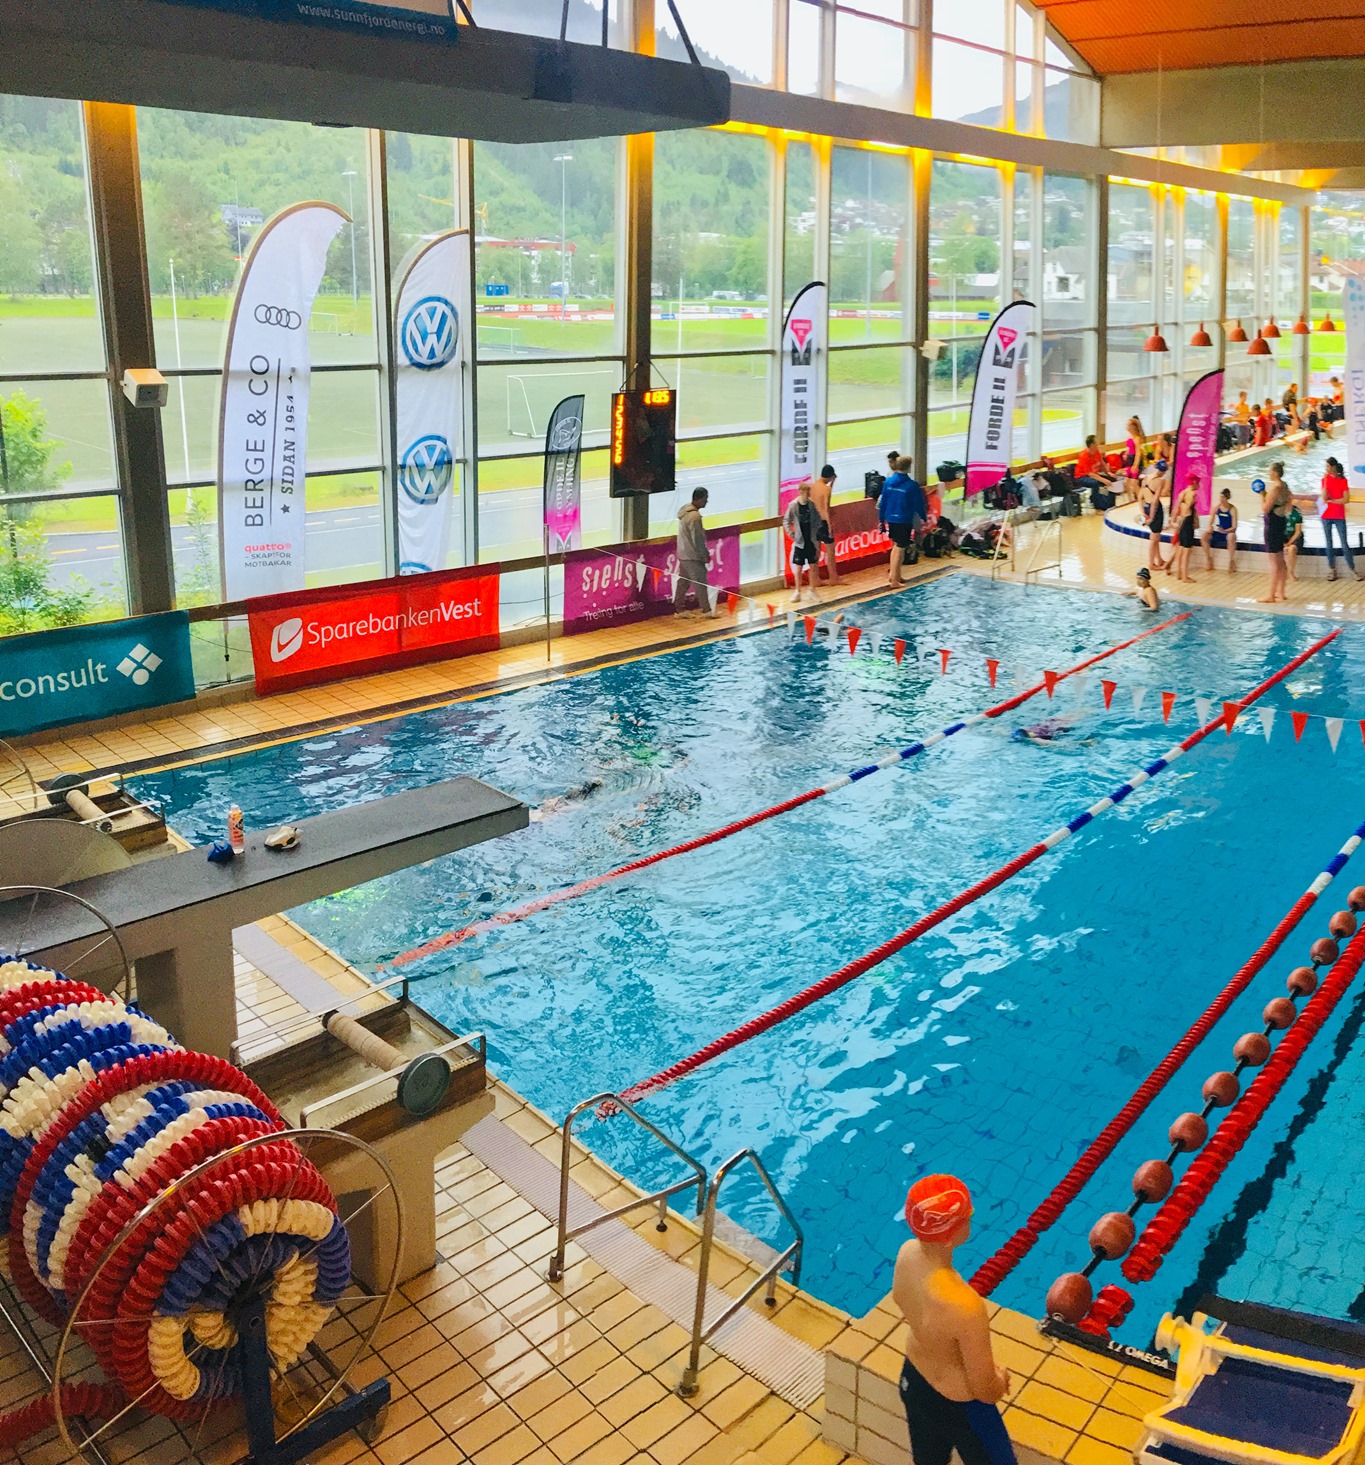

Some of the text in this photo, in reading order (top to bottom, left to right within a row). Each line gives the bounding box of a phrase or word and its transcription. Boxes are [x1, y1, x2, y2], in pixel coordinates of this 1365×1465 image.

[244, 355, 270, 528] BERGE & CO
[280, 439, 296, 495] SIDAN
[307, 598, 483, 649] SparebankenVest
[1125, 1346, 1169, 1369] OMEGA
